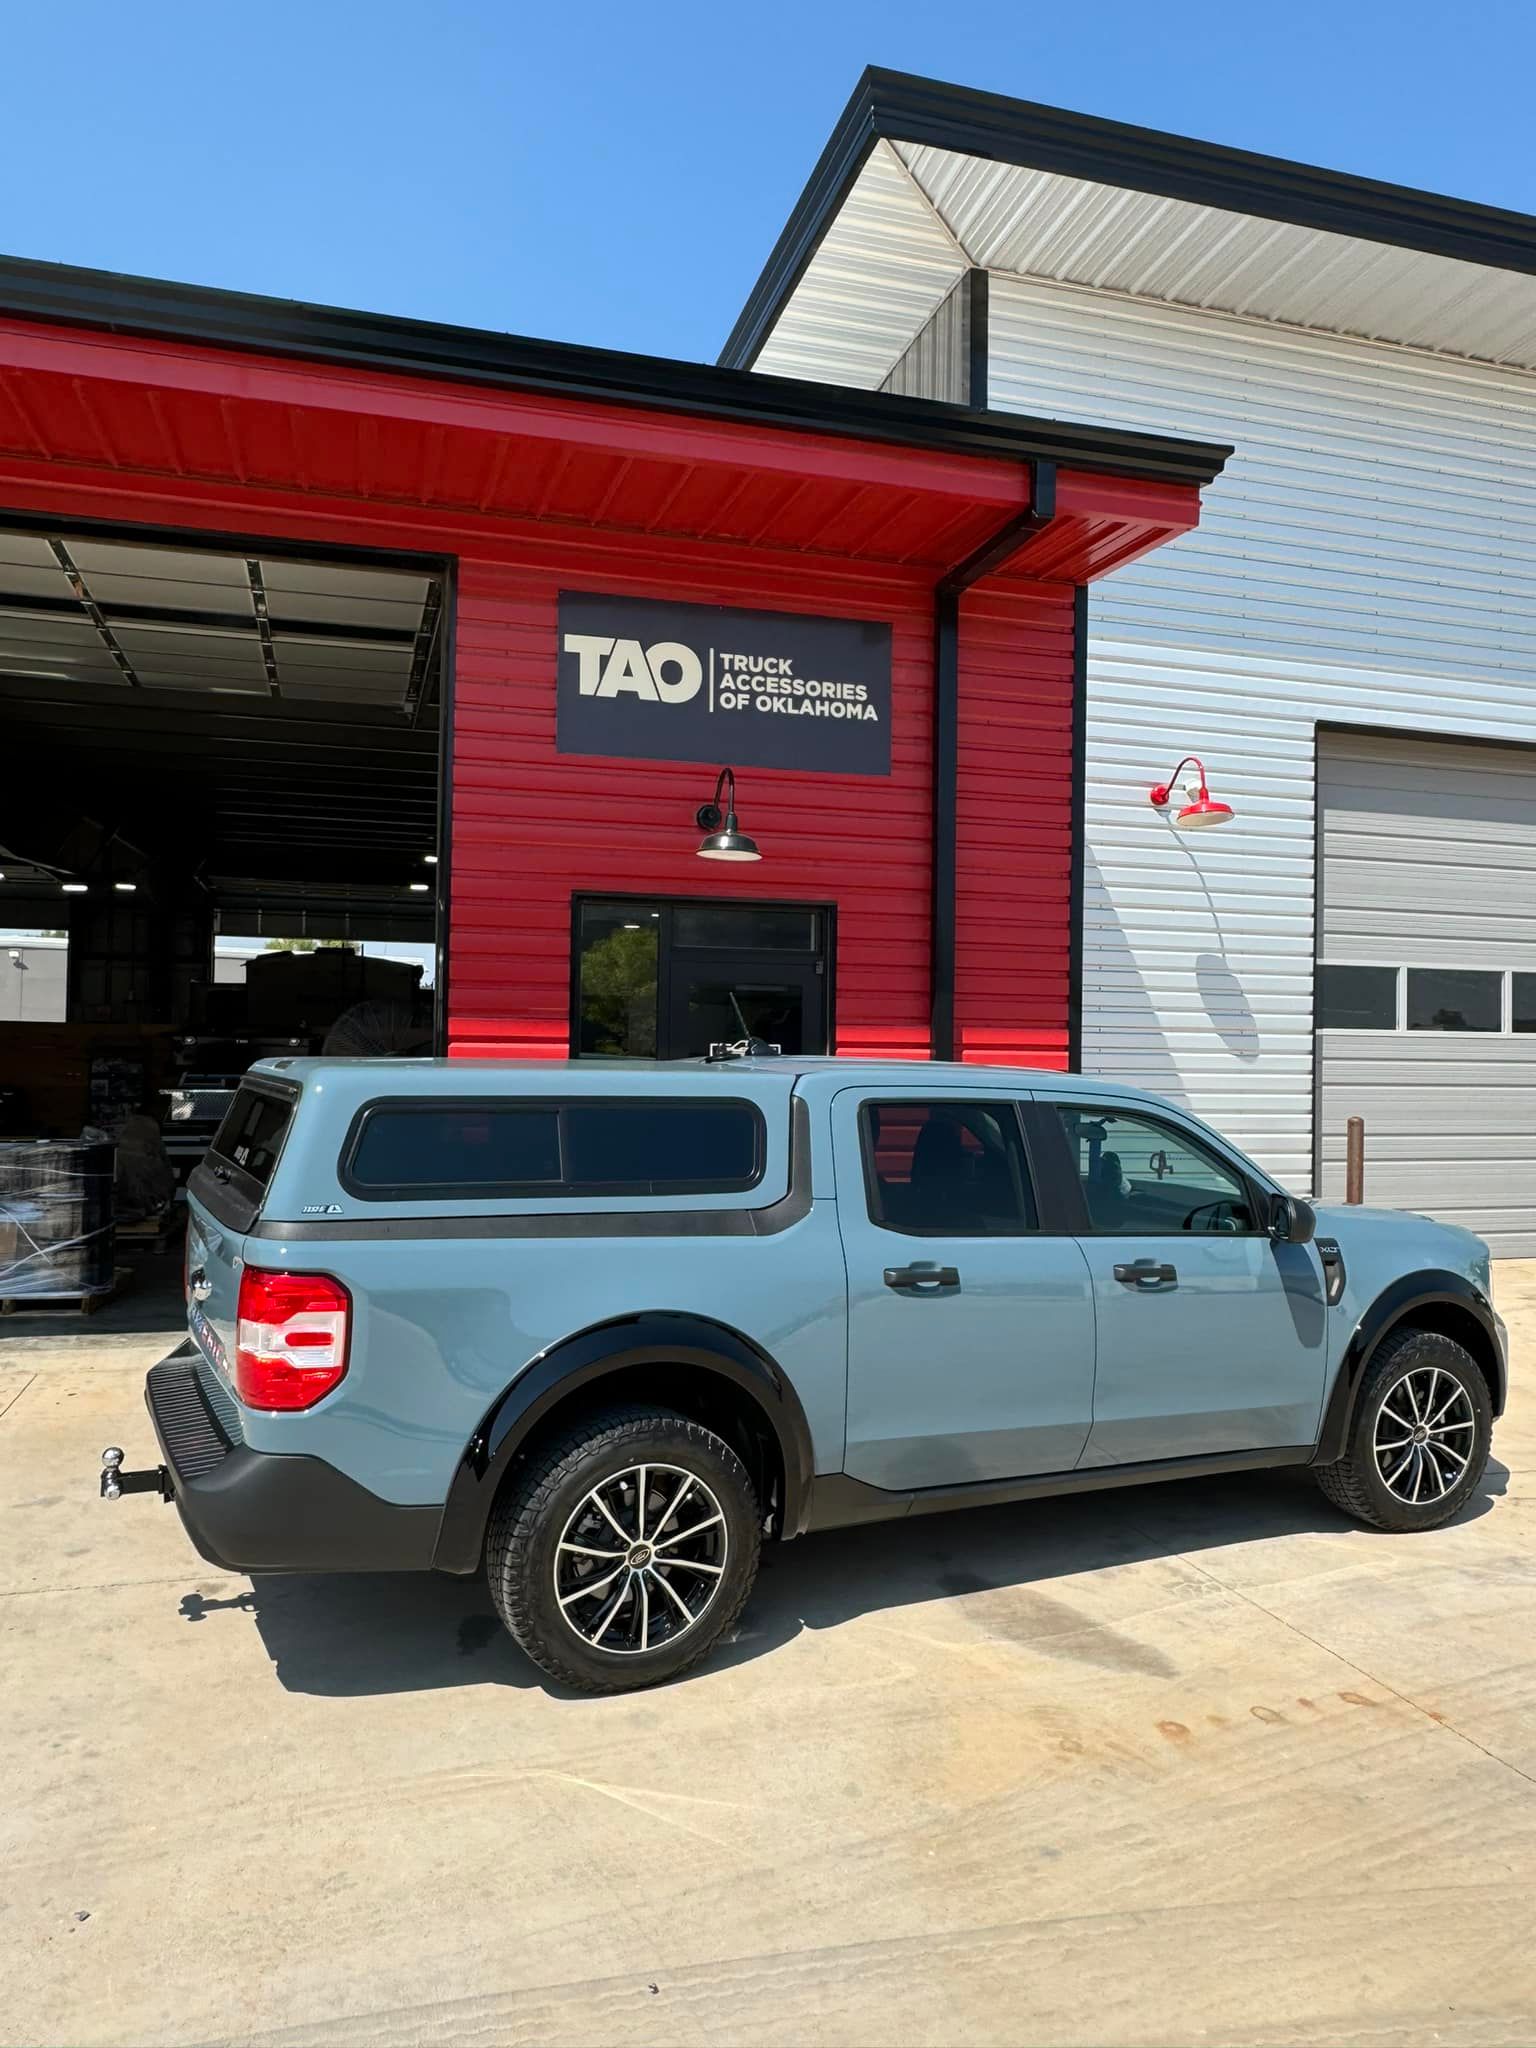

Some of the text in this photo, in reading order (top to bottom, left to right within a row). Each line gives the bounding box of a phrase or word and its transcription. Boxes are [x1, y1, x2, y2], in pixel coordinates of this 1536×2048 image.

[563, 633, 703, 704] TAO
[719, 653, 793, 676] TRUCK
[719, 672, 868, 702] ACCESSORIES
[719, 691, 879, 721] OF OKLAHOMA
